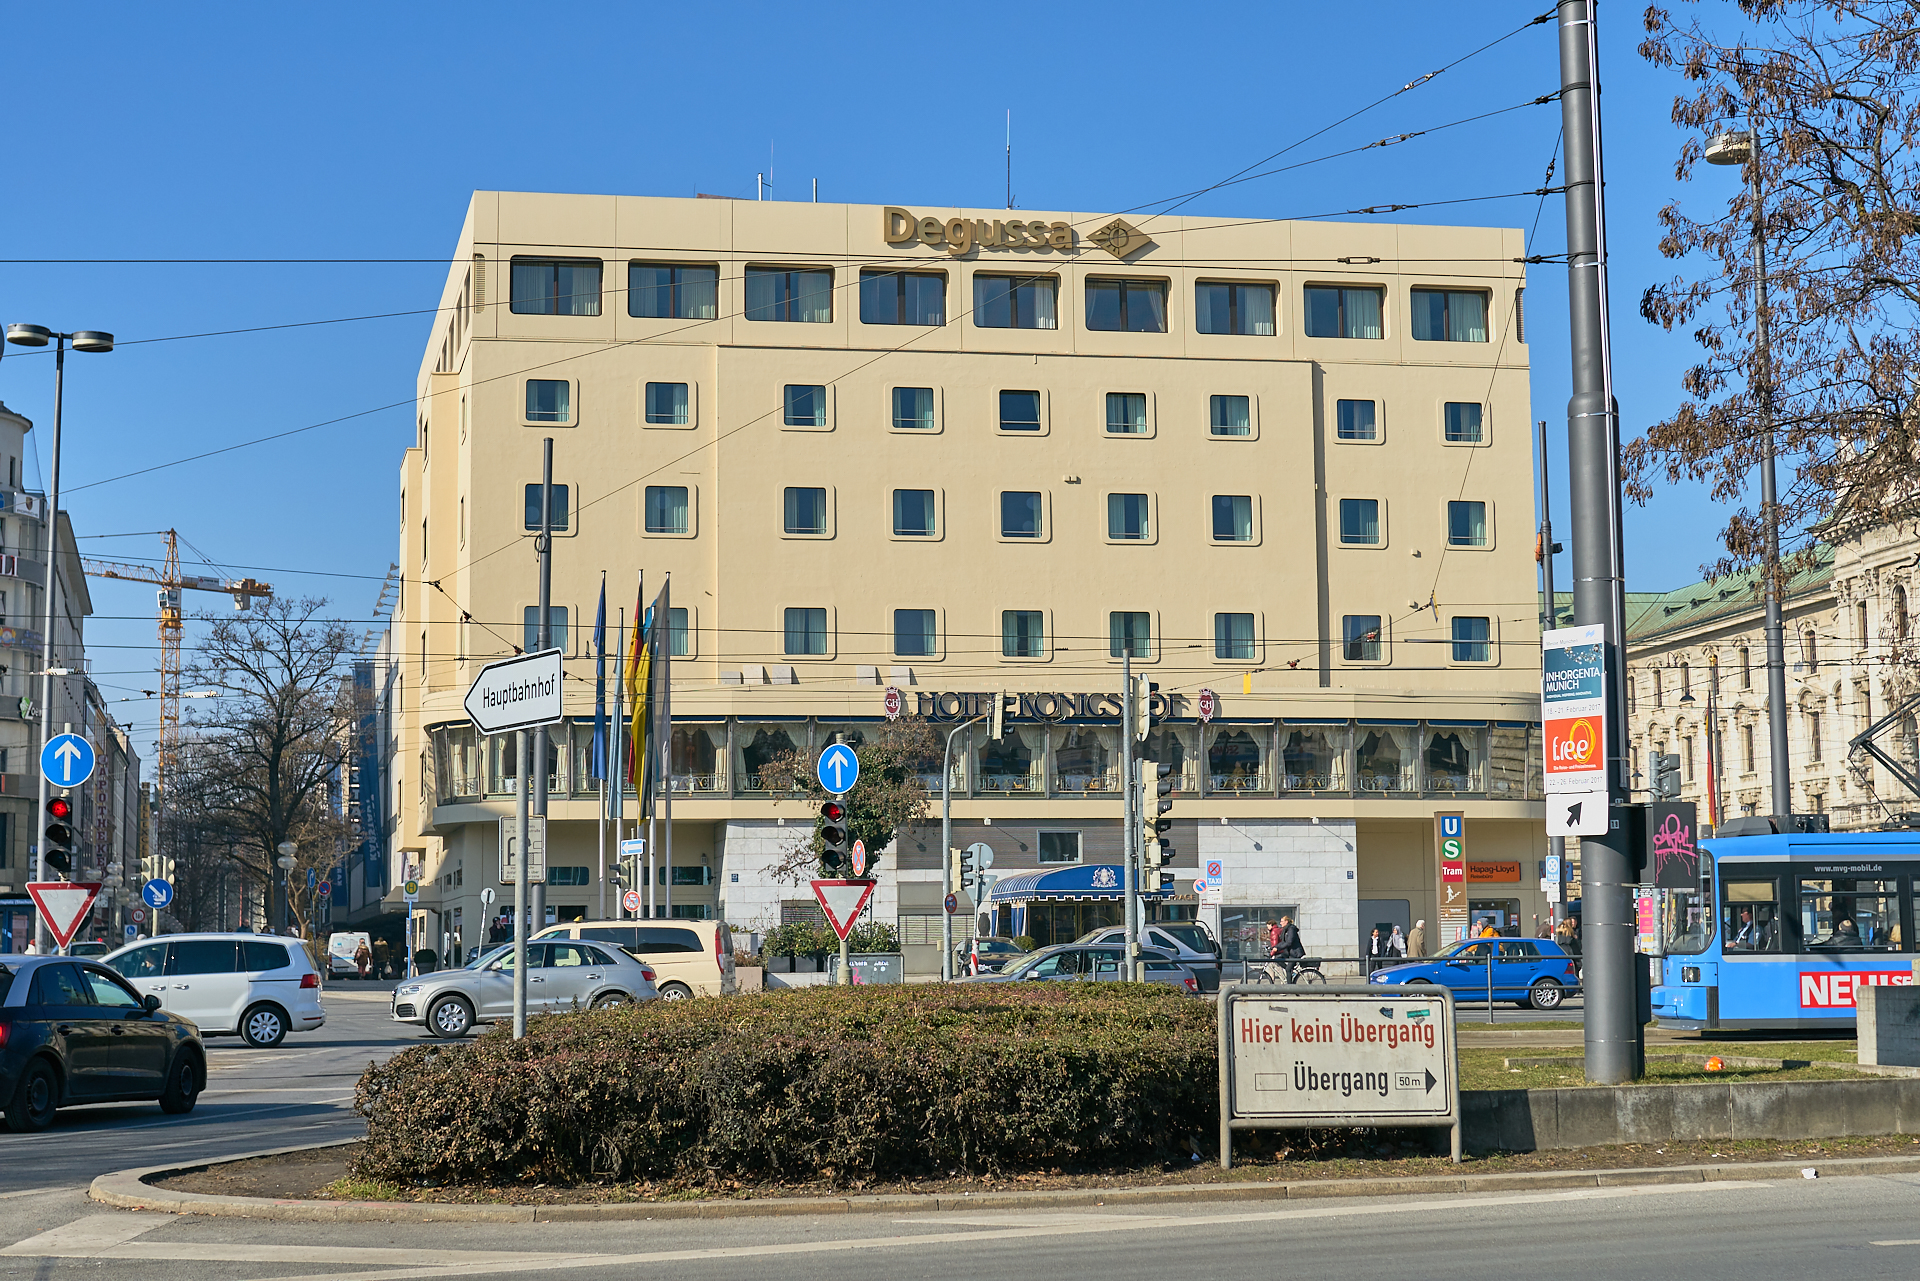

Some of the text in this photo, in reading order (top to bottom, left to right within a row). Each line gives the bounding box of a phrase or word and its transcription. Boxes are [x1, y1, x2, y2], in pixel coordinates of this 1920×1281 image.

[884, 206, 1072, 255] Degussa
[1545, 667, 1600, 682] INHORGENTA
[483, 673, 555, 710] Hauptbahnhof
[1545, 679, 1580, 692] MUNICH
[914, 691, 1187, 723] HOTE KÖNIGSOF
[1588, 703, 1601, 711] 2017
[1568, 777, 1589, 785] Februar
[1590, 776, 1603, 784] 2017
[1444, 818, 1458, 835] U
[1444, 840, 1459, 859] S
[1443, 866, 1463, 876] Tram
[1470, 865, 1515, 874] Hapag-Lloyd
[1814, 864, 1883, 873] www.mvg-mobil.de
[1241, 1013, 1435, 1049] Hier kein Übergang
[1294, 1061, 1388, 1097] Übergang
